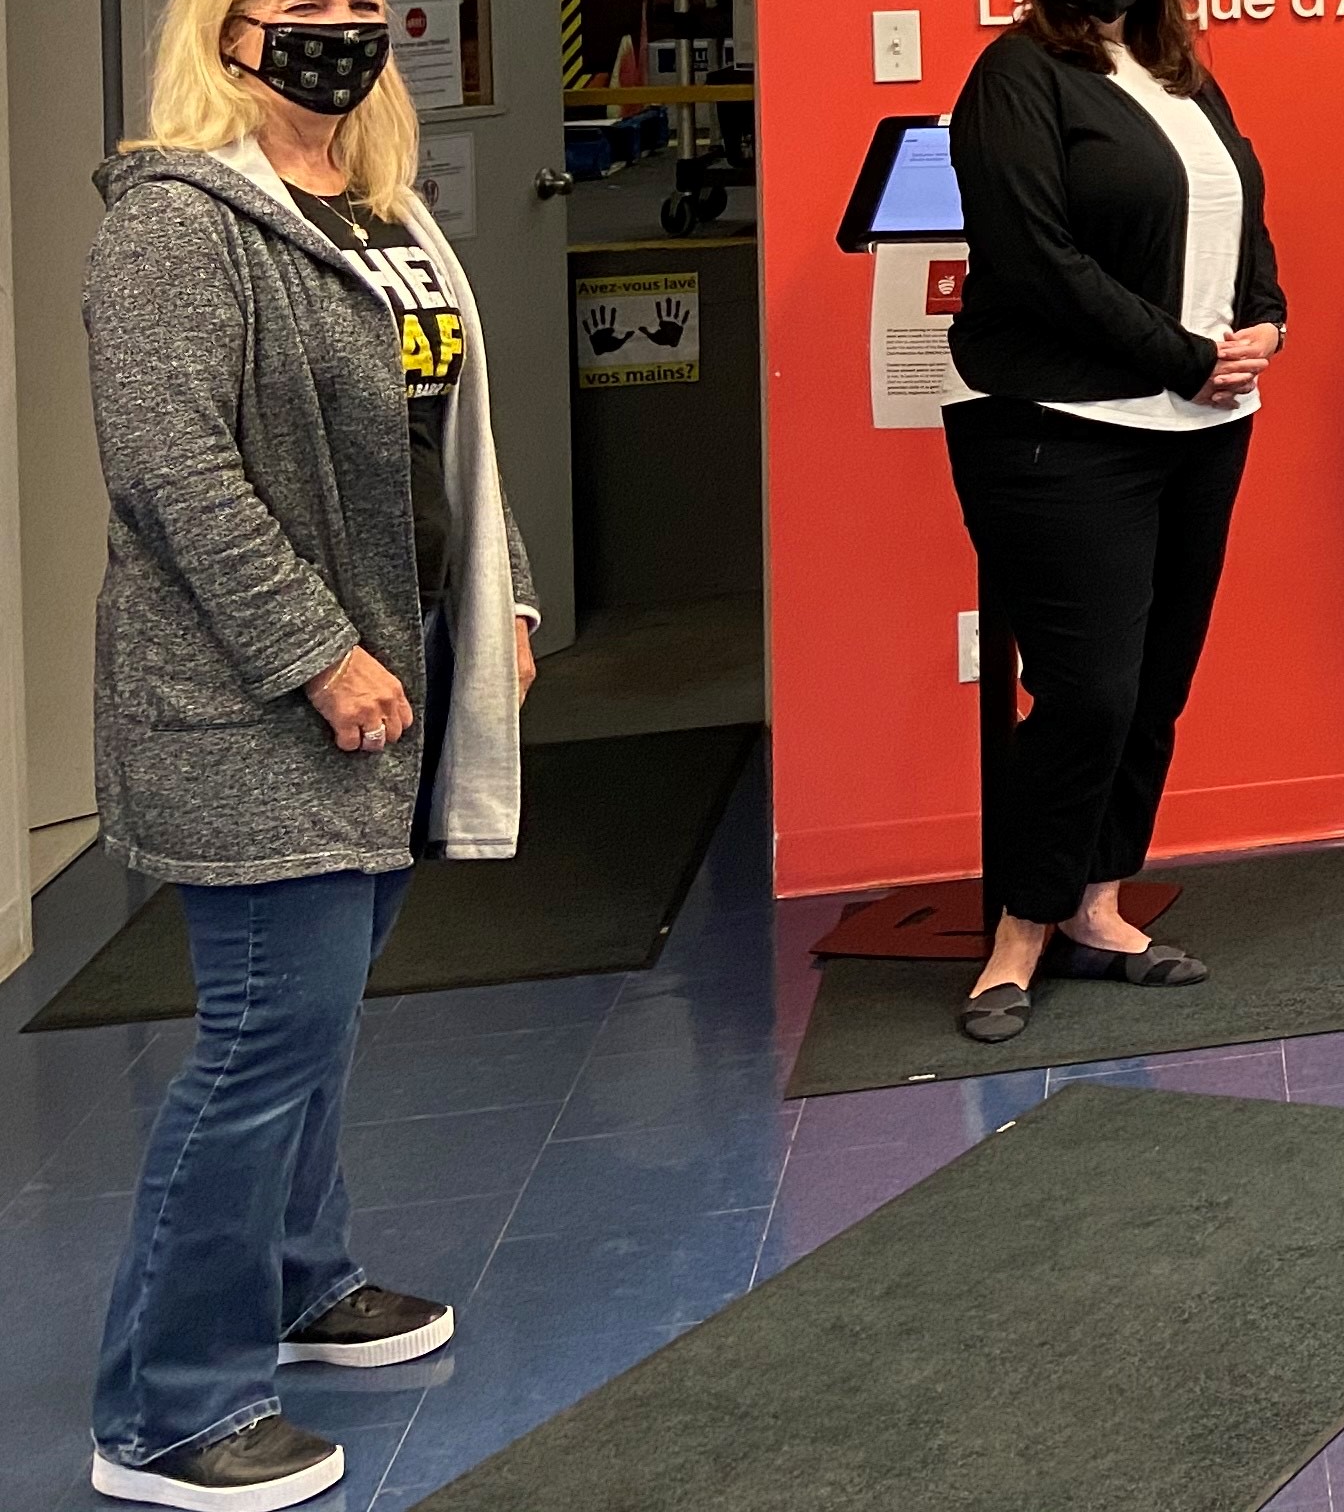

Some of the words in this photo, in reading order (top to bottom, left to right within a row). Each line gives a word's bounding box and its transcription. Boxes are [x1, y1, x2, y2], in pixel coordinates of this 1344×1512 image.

[578, 280, 661, 295] Avez-vous
[664, 276, 696, 290] lavé
[585, 370, 620, 385] vos
[626, 362, 694, 382] mains?
